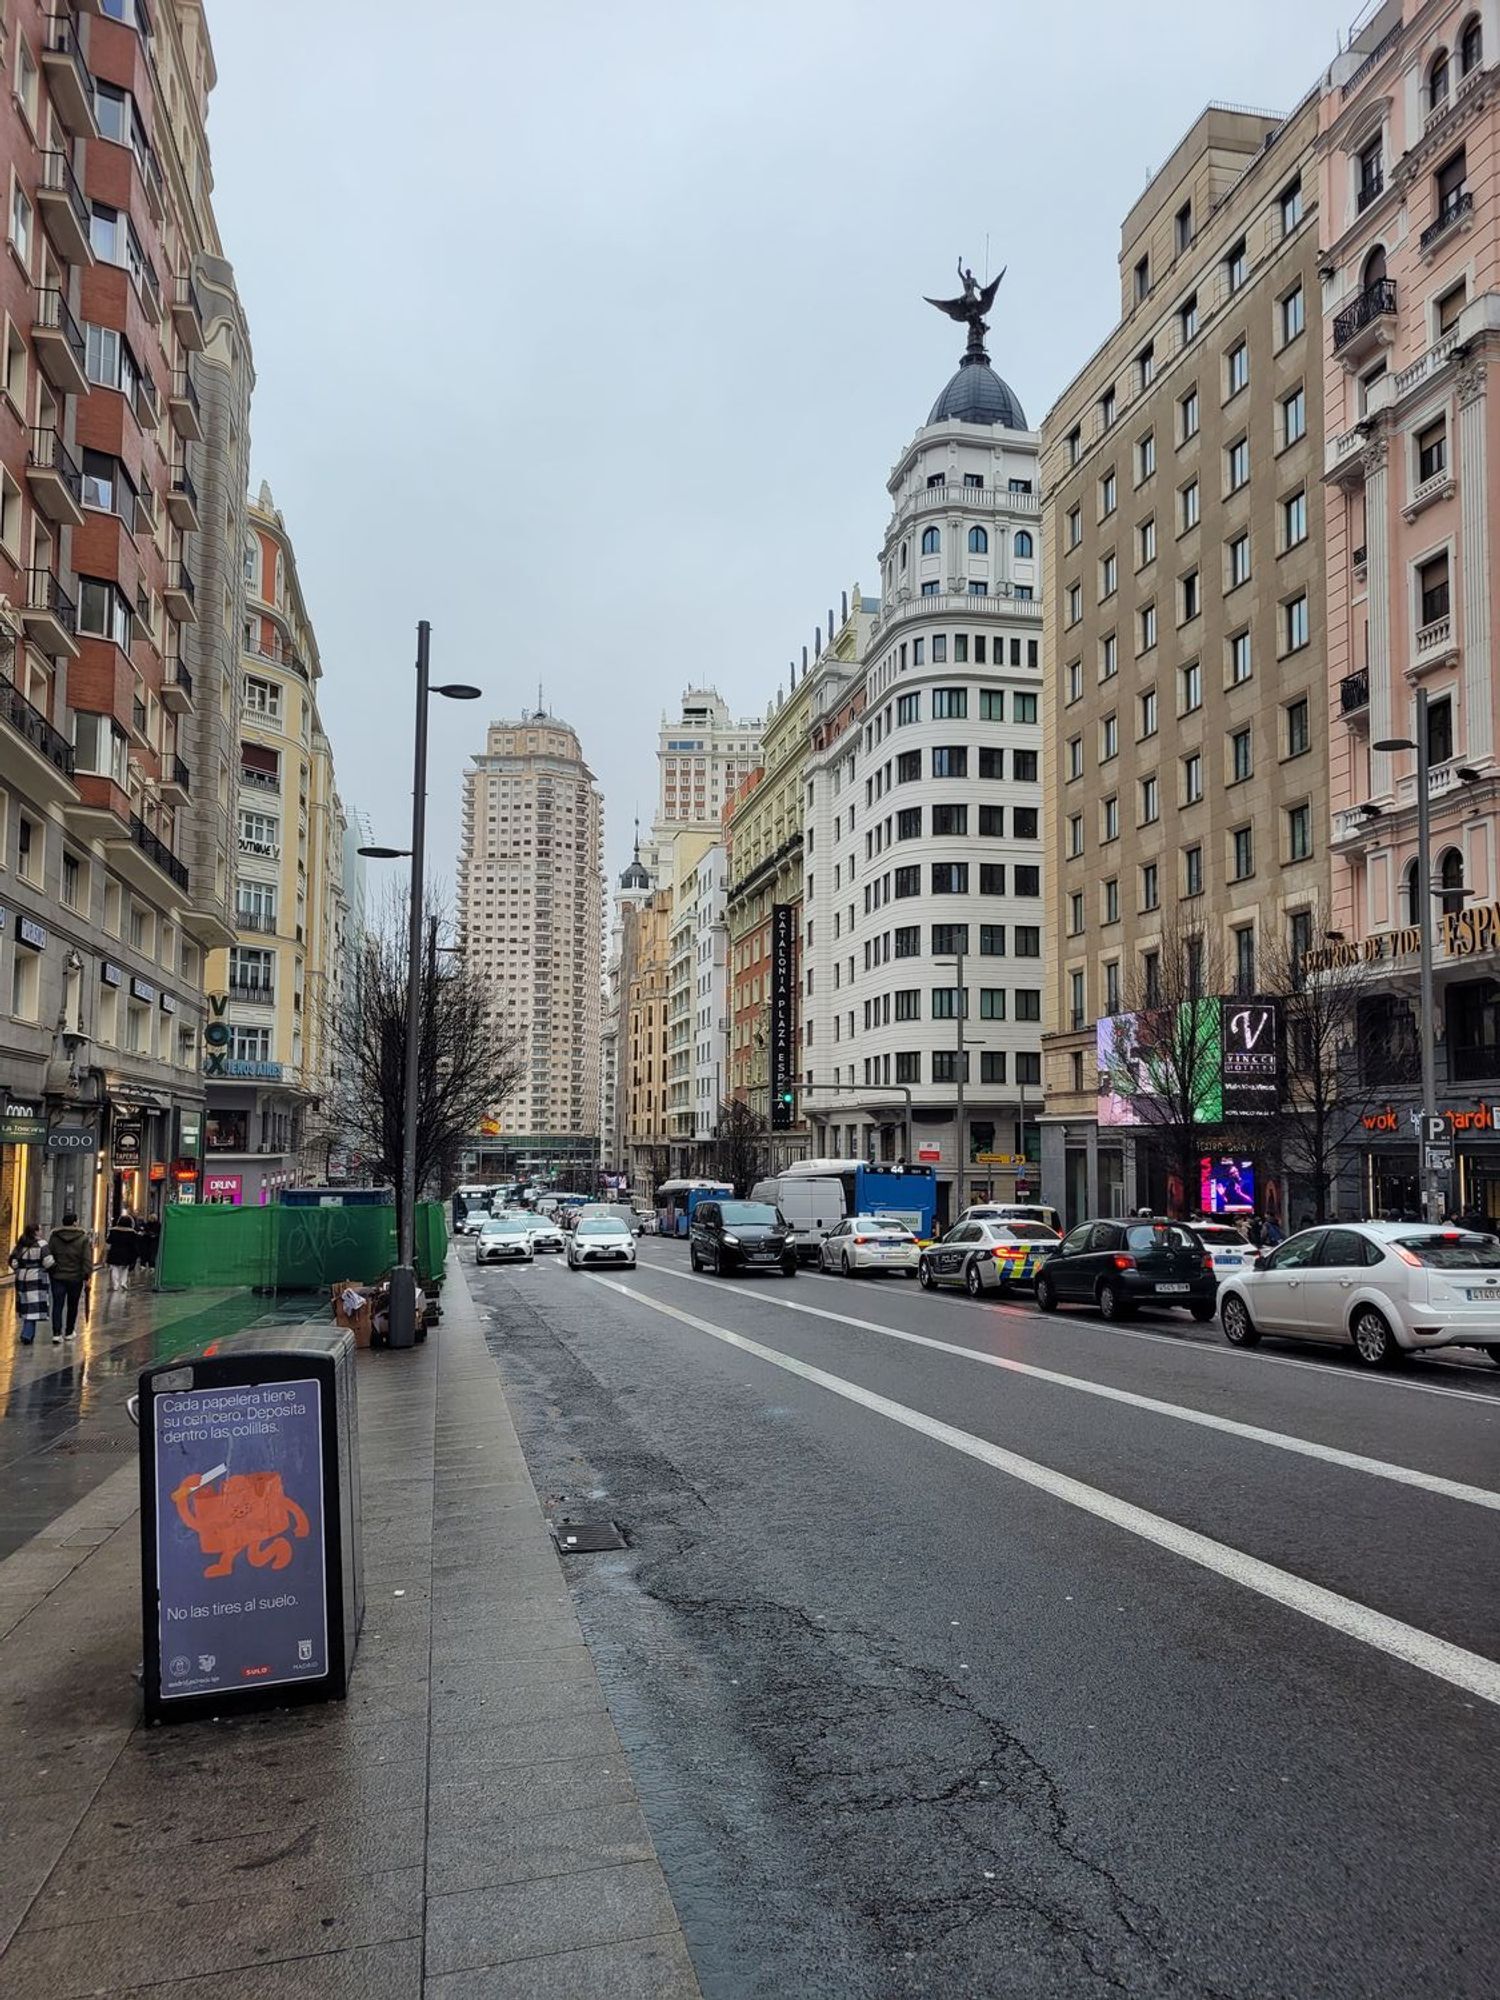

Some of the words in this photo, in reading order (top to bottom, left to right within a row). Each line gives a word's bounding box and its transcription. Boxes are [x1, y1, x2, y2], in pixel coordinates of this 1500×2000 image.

[238, 839, 271, 856] OUTIQUE
[778, 911, 786, 994] CATALONIA
[1300, 942, 1359, 973] SEGUROS
[1365, 937, 1383, 962] DE
[205, 995, 231, 1076] VOX
[778, 1000, 786, 1047] PLAZA
[1362, 1105, 1397, 1130] wok
[1429, 1117, 1445, 1140] P
[48, 1135, 93, 1148] CODO
[210, 1180, 237, 1190] DRUNI
[163, 1399, 199, 1413] Cada
[203, 1394, 260, 1411] papelera
[263, 1390, 296, 1403] tiene
[163, 1417, 180, 1428] su
[183, 1411, 244, 1426] cenicero.
[247, 1403, 306, 1421] Deposita
[163, 1428, 208, 1444] dentro
[211, 1426, 231, 1439] las
[232, 1422, 280, 1437] colillas.
[167, 1607, 188, 1621] No
[190, 1605, 210, 1618] las
[213, 1602, 241, 1616] tires
[244, 1599, 256, 1612] al
[259, 1594, 299, 1610] suelo.
